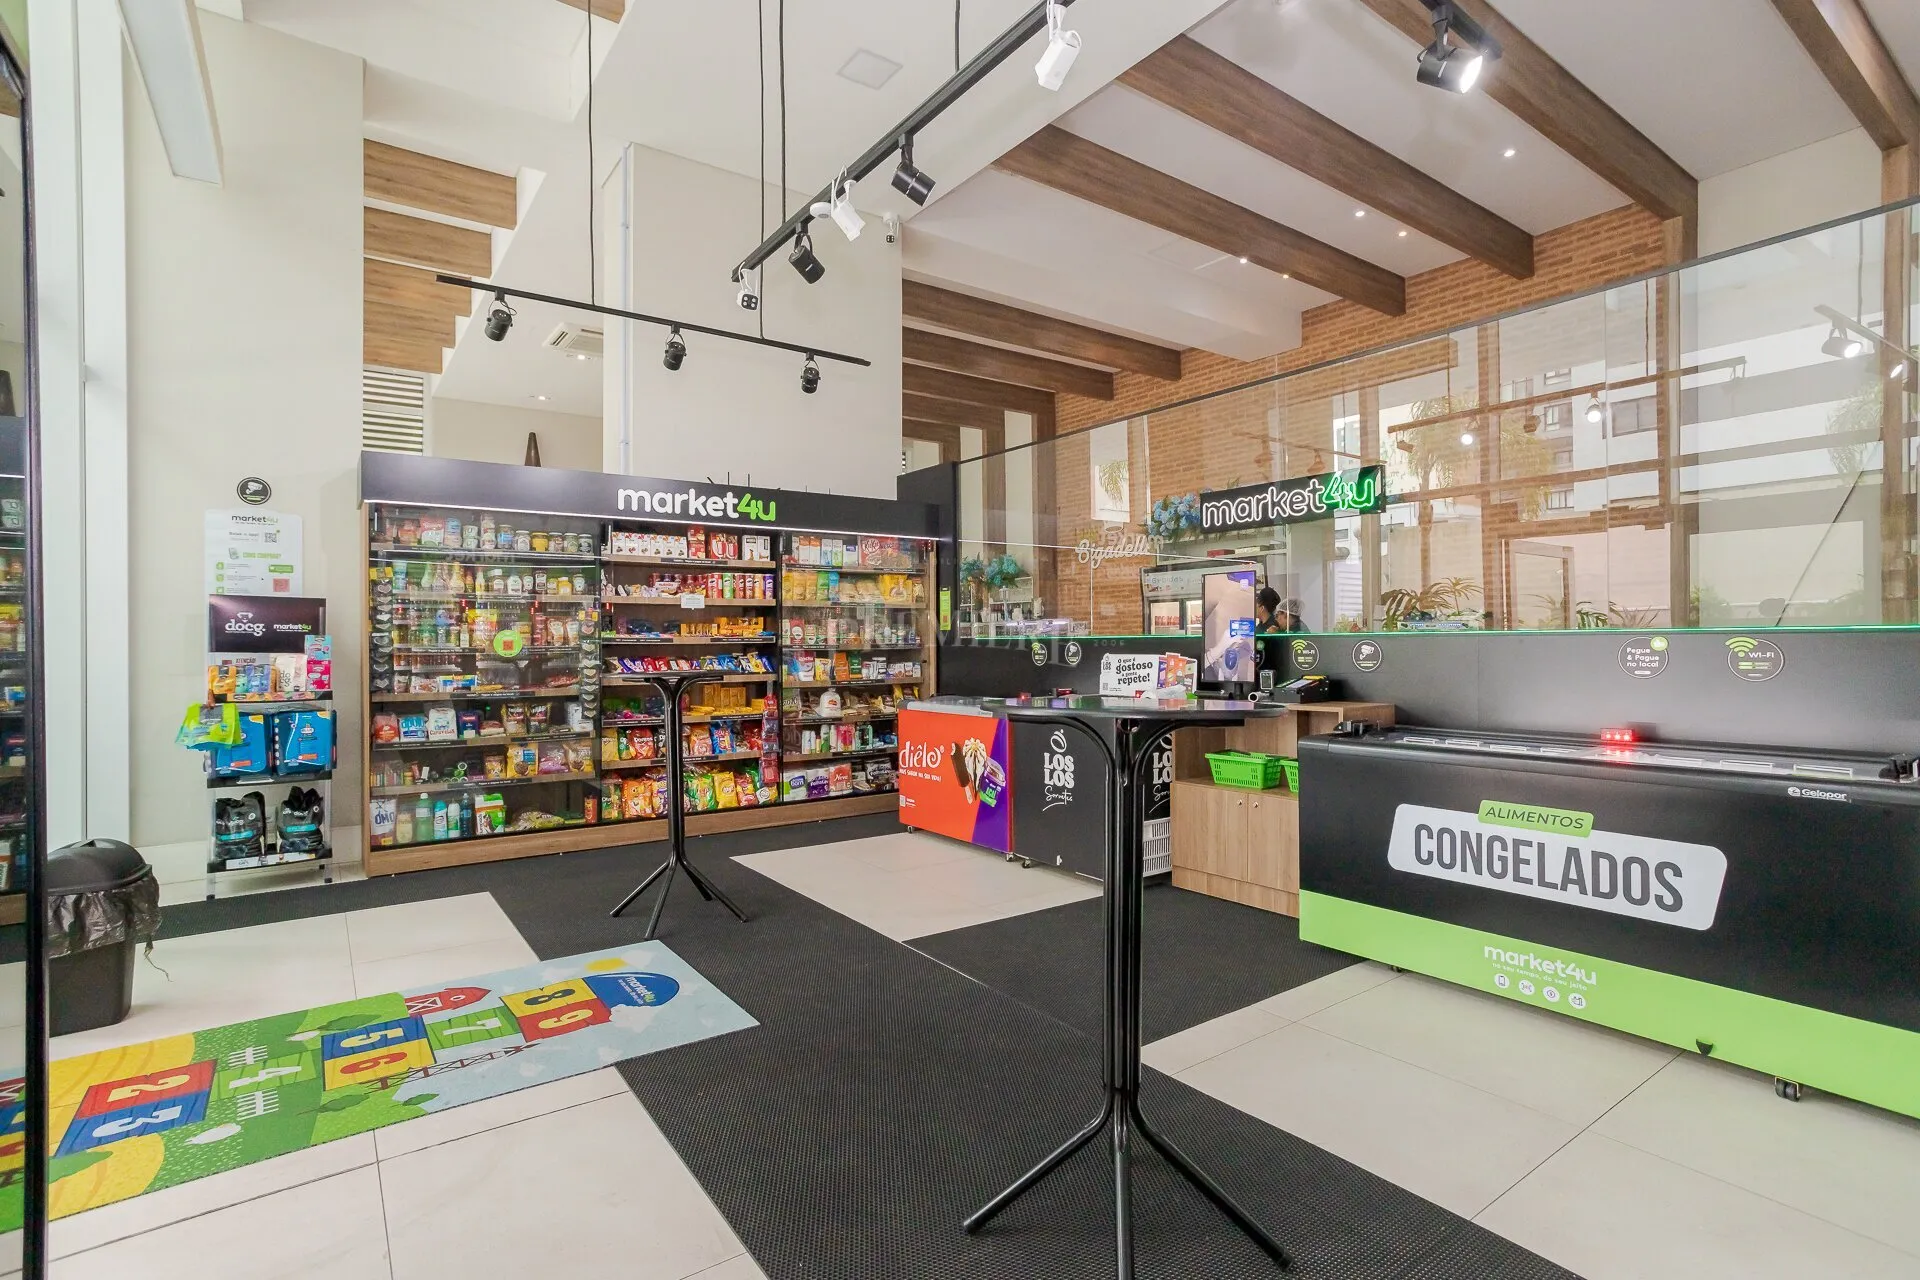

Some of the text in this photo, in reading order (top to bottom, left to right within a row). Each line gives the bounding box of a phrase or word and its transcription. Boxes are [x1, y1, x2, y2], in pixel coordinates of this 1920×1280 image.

[617, 488, 776, 522] market4u
[1202, 472, 1375, 528] market4u
[231, 515, 279, 524] market4u
[224, 618, 267, 637] docg.
[273, 623, 312, 631] market4u
[1627, 647, 1651, 655] Pegue
[1635, 654, 1660, 662] Pague
[1747, 651, 1775, 659] WI-FI
[1115, 661, 1153, 675] gostoso
[1639, 660, 1659, 668] local
[1118, 672, 1151, 686] repete!
[898, 740, 942, 769] diêlo
[1043, 752, 1075, 772] LOS
[1152, 751, 1172, 768] LO
[1043, 768, 1075, 789] LOS
[1152, 767, 1172, 785] LO
[1802, 788, 1848, 801] Gelopor
[1484, 806, 1585, 830] ALIMENTOS
[1414, 822, 1684, 913] CONGELADOS
[1483, 945, 1598, 986] market4u
[624, 976, 657, 1004] market4u
[1569, 981, 1588, 991] jeito
[523, 988, 577, 1006] 8
[442, 1014, 504, 1037] 7
[340, 1027, 405, 1049] 5
[228, 1065, 303, 1090] 4
[106, 1073, 193, 1102] 2
[92, 1104, 184, 1139] 3
